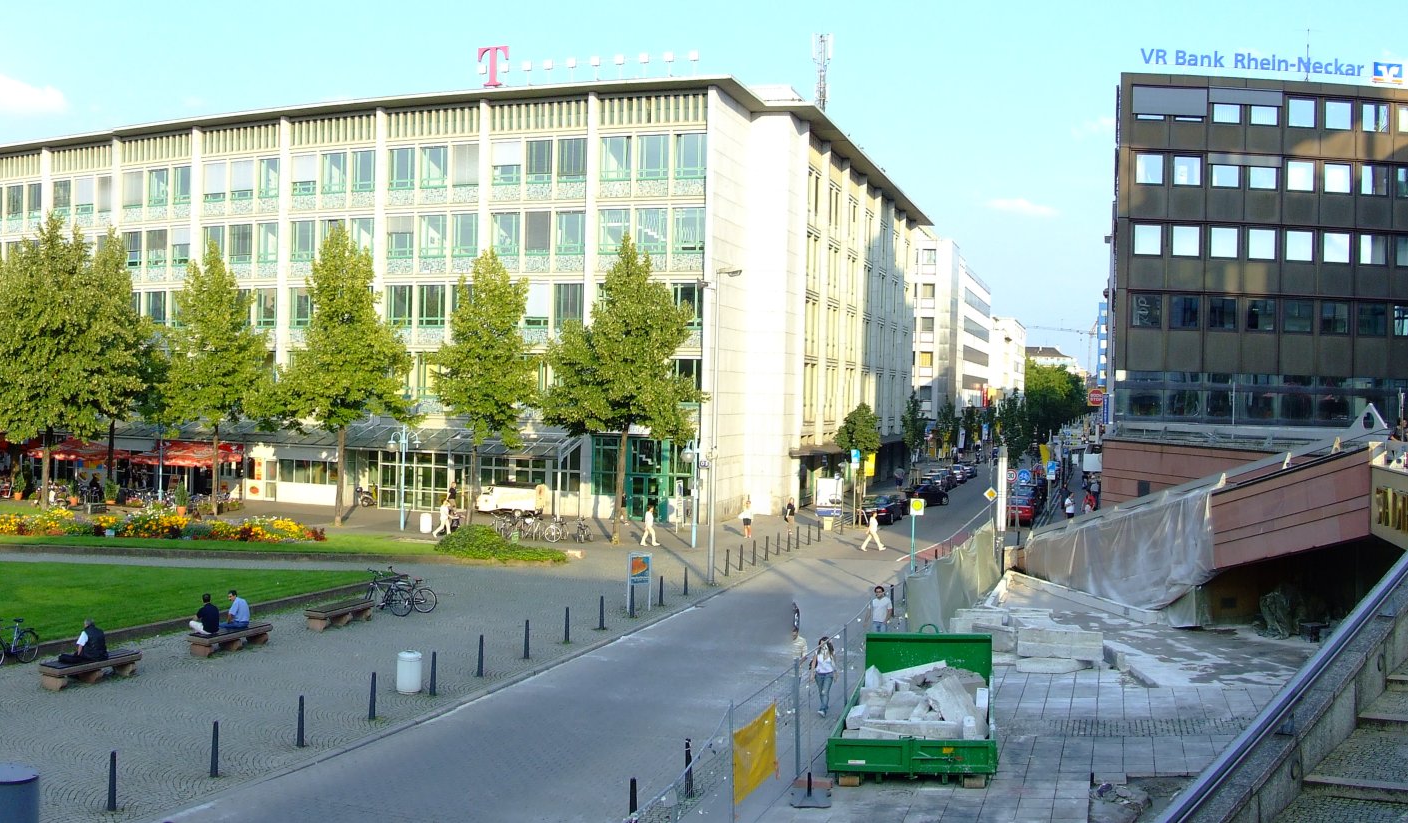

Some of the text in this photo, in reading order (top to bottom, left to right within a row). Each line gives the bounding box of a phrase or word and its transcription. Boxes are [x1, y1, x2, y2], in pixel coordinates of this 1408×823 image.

[478, 46, 509, 86] T
[1140, 48, 1364, 76] VR Bank Rhein-Neckar
